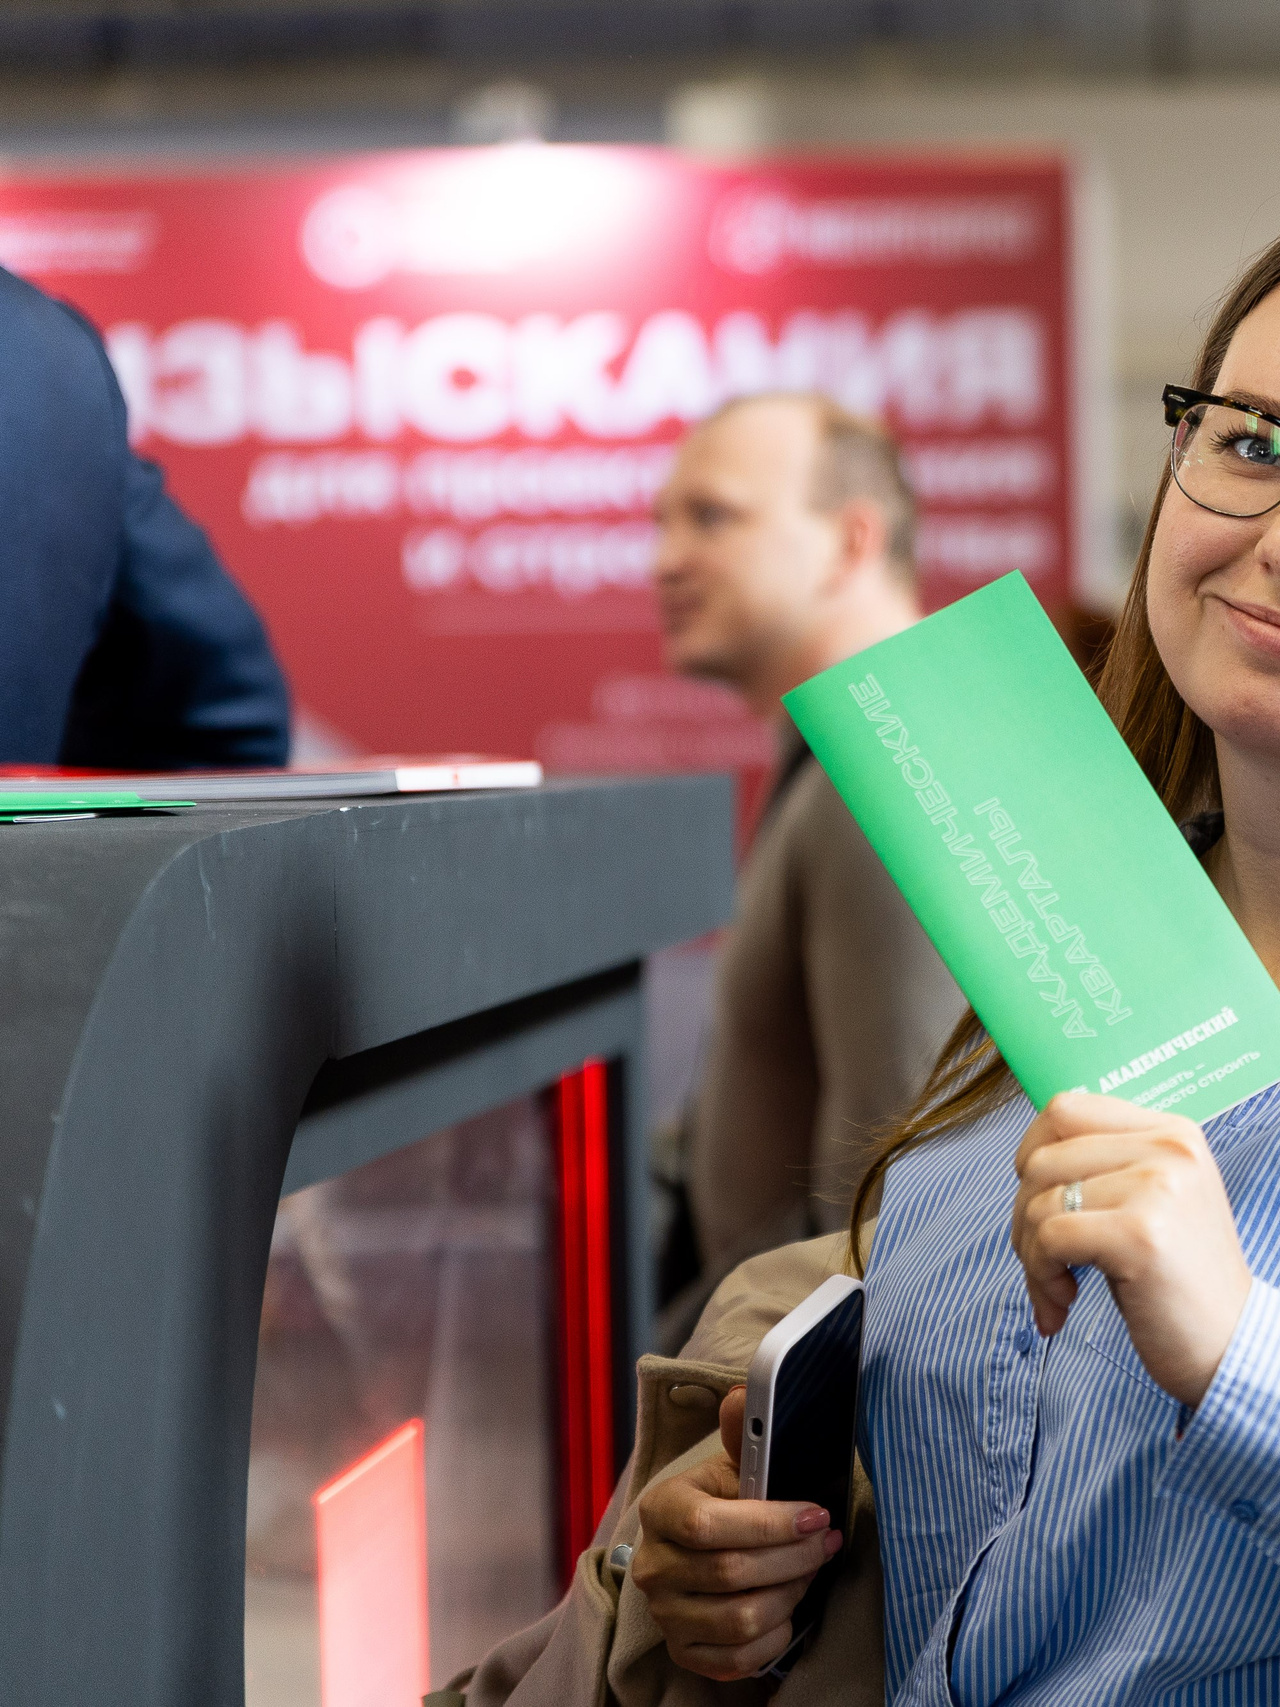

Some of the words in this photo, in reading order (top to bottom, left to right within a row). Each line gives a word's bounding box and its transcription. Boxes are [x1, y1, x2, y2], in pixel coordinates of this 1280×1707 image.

[848, 673, 1097, 1039] АКАДЕМИЧЕСКИЕ
[973, 797, 1133, 1026] КВАРТАЛЫ
[1098, 1006, 1239, 1094] АКАДЕМИЧЕСКИЙ
[1130, 1069, 1195, 1107] здавать
[1150, 1083, 1198, 1113] росто
[1197, 1050, 1261, 1089] строить
